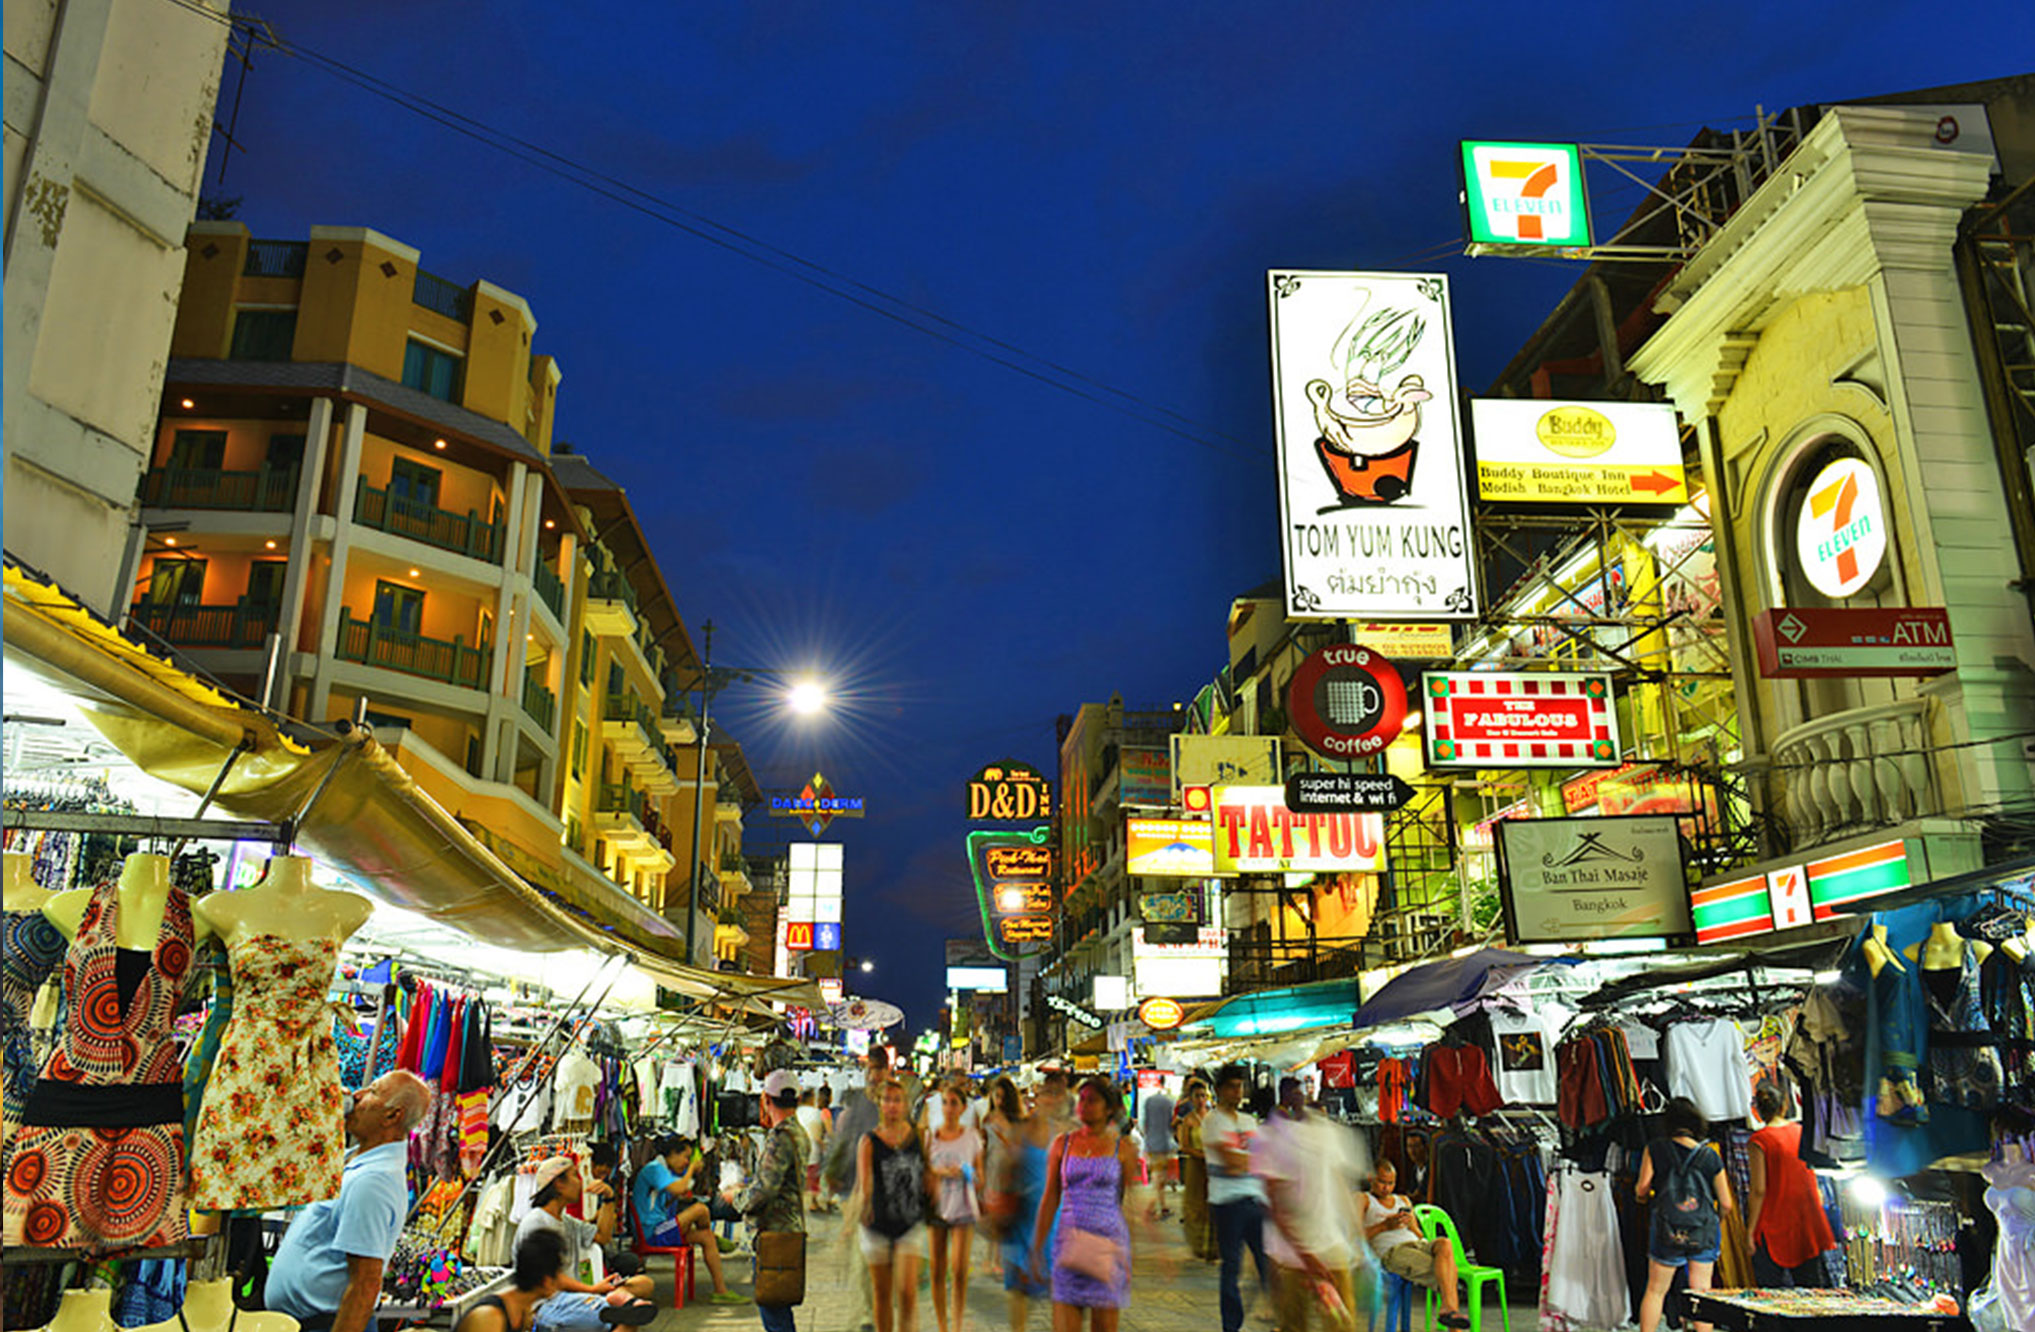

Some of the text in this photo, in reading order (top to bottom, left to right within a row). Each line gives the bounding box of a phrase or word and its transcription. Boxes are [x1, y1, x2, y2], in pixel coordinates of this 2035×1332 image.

[1548, 415, 1603, 439] Buddy
[1480, 466, 1626, 483] Buddy Boutique Inn
[1537, 484, 1591, 496] Bangkok
[1597, 484, 1631, 496] Hotel
[1294, 524, 1463, 559] TOM YUM KUNG
[1893, 621, 1949, 644] ATM
[1322, 649, 1370, 666] true
[1503, 701, 1536, 711] THE
[1463, 713, 1579, 728] FABULOUS
[1323, 735, 1383, 753] coffee
[1300, 777, 1394, 791] super hi speed
[970, 782, 1037, 819] D&D
[1299, 791, 1351, 804] internet
[1353, 792, 1364, 803] &
[1218, 804, 1378, 858] TATTOO
[1543, 868, 1649, 885] Ban Thai Masaje
[1572, 899, 1628, 913] Bangkok
[1776, 873, 1797, 923] 7
